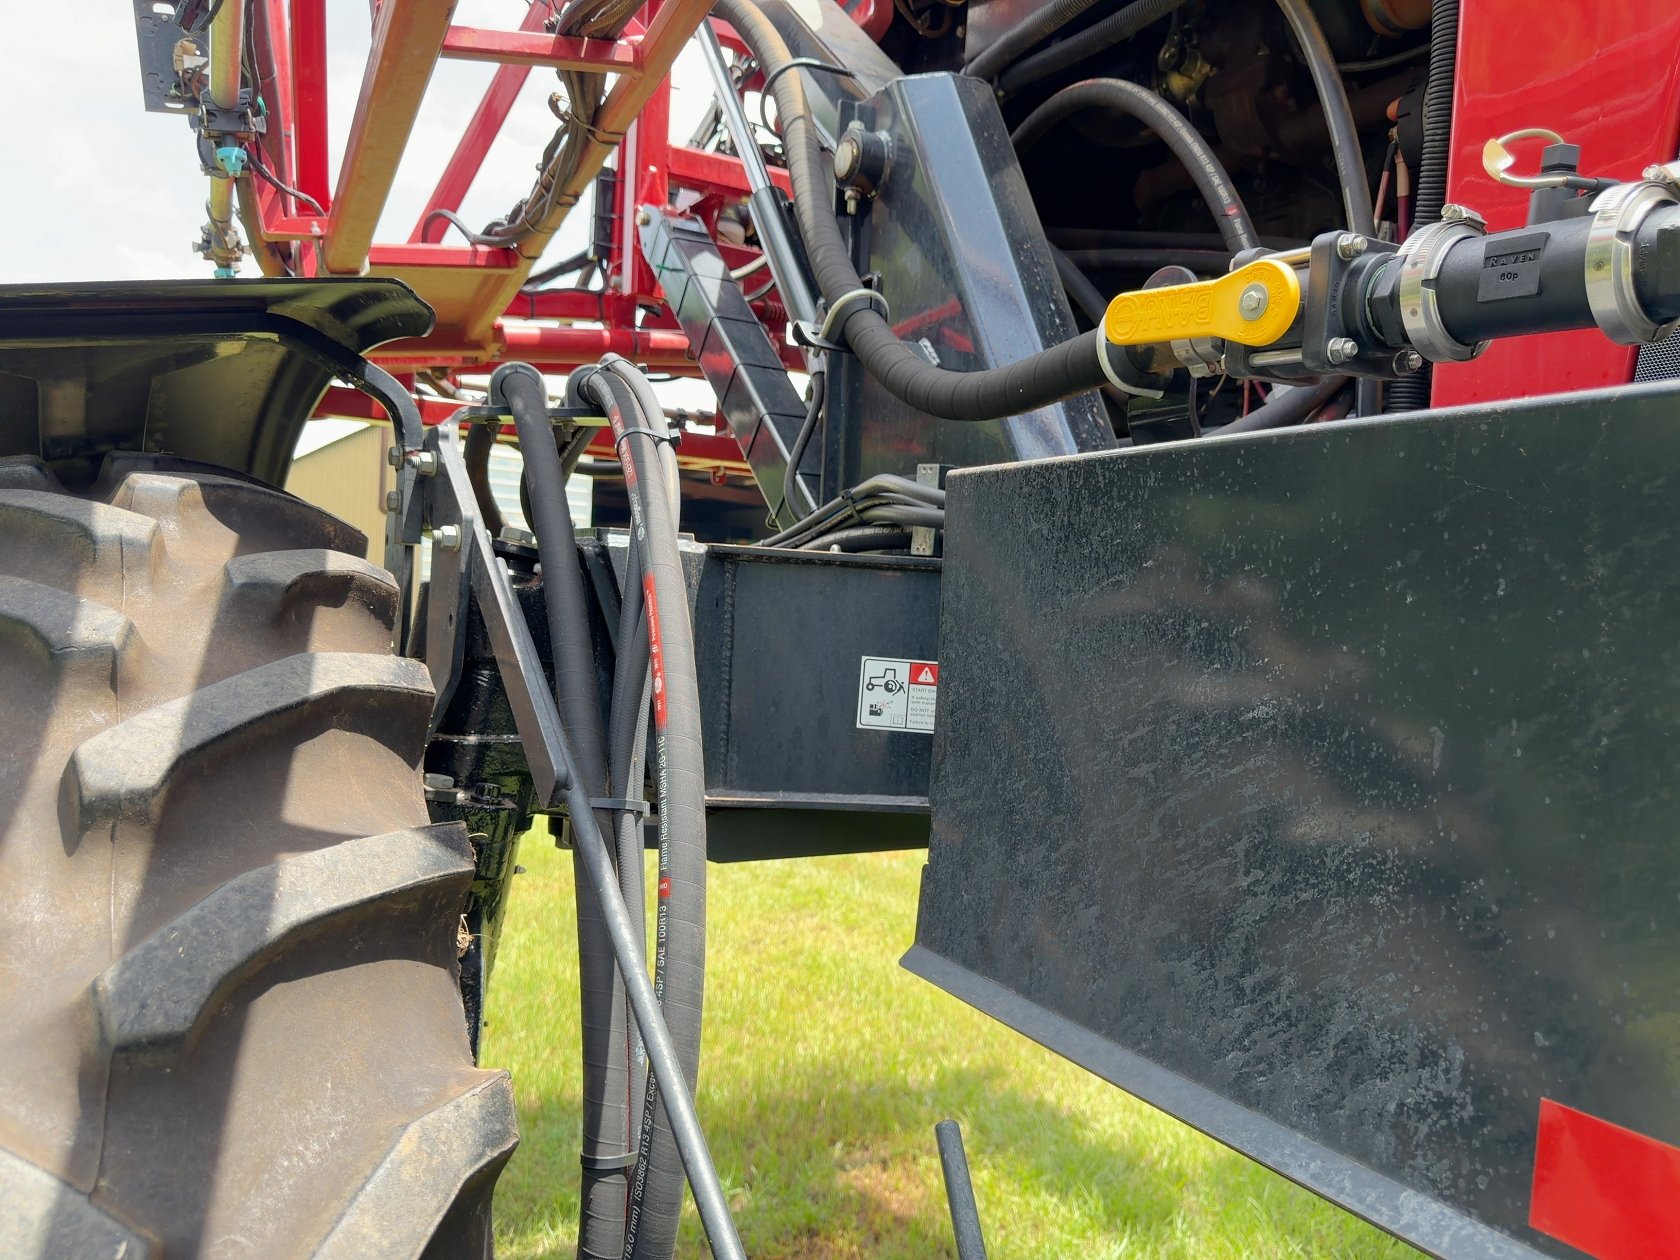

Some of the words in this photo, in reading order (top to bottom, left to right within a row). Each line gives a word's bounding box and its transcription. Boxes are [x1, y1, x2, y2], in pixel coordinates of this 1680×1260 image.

[1489, 253, 1535, 267] RAVEN
[1245, 271, 1272, 284] OPEN
[1499, 272, 1519, 282] 60p
[657, 736, 666, 769] 2G-11C
[659, 770, 667, 798] MSHA
[659, 800, 668, 841] Resistant
[660, 842, 668, 871] Flame
[658, 905, 667, 942] 100R13
[657, 946, 665, 967] SAE
[655, 980, 663, 997] 4SP
[643, 1113, 652, 1133] 4SP
[641, 1135, 650, 1157] R13
[634, 1159, 648, 1201] ISO3862
[630, 1205, 641, 1234] mm)
